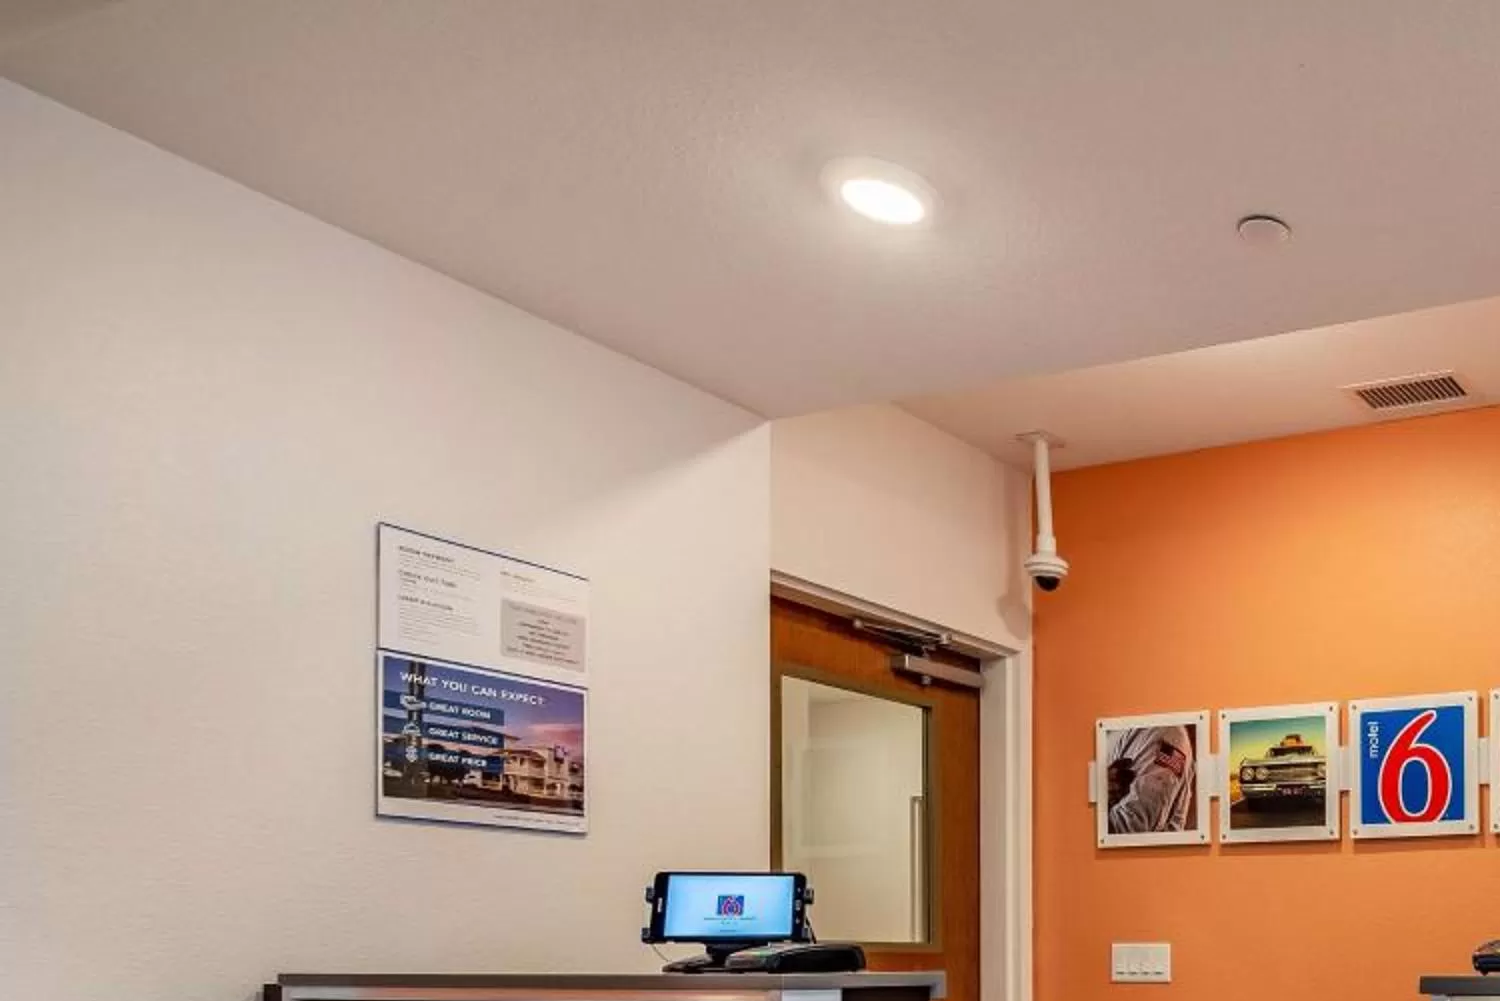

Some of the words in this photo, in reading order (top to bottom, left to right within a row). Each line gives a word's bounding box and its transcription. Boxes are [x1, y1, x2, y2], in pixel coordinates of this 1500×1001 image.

[400, 672, 438, 687] WHAT
[441, 679, 467, 693] YOU
[471, 685, 497, 698] CAN
[429, 701, 458, 714] GREAT
[461, 707, 491, 719] ROOM
[428, 727, 459, 739] GREAT
[461, 732, 498, 745] SERVICE
[1367, 721, 1379, 759] motel
[429, 752, 459, 764] GREAT
[461, 757, 488, 767] PRICE
[1378, 710, 1452, 824] 6
